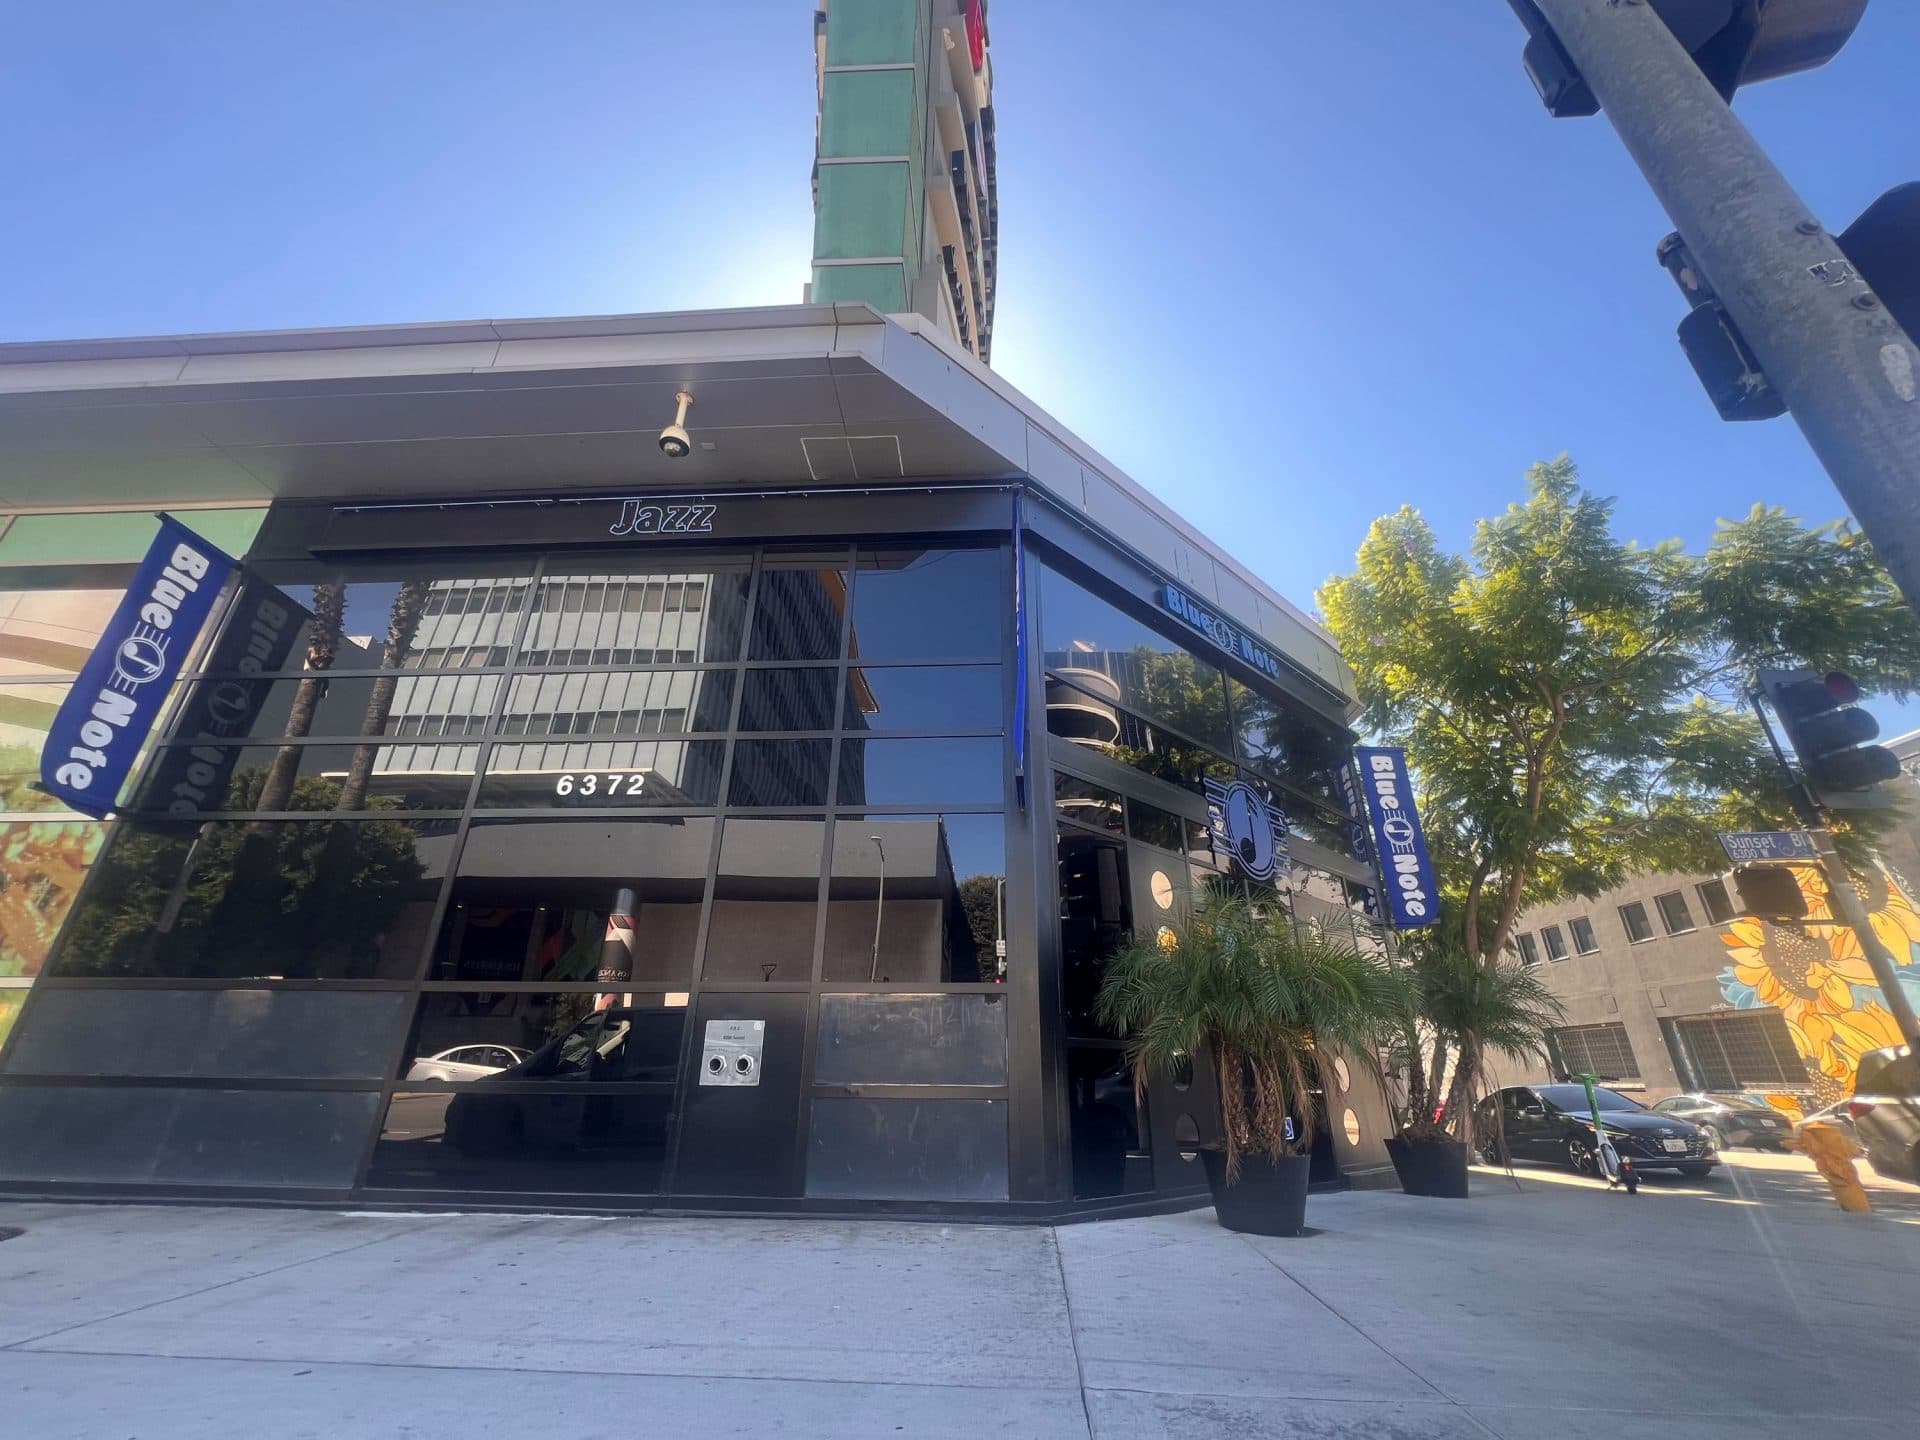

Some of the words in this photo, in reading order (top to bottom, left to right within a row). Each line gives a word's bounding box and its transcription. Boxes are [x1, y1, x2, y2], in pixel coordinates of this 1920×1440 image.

[609, 500, 717, 536] Jazz
[141, 543, 210, 630] Blue
[1164, 583, 1214, 638] Blue
[1240, 635, 1280, 678] Note
[56, 688, 138, 790] Note
[556, 774, 645, 796] 6372
[1370, 755, 1399, 810] Blue
[1393, 854, 1426, 917] Note
[1726, 834, 1777, 849] Sunset
[1789, 832, 1807, 847] Bl
[1732, 848, 1758, 859] 6300
[1761, 848, 1769, 858] W
